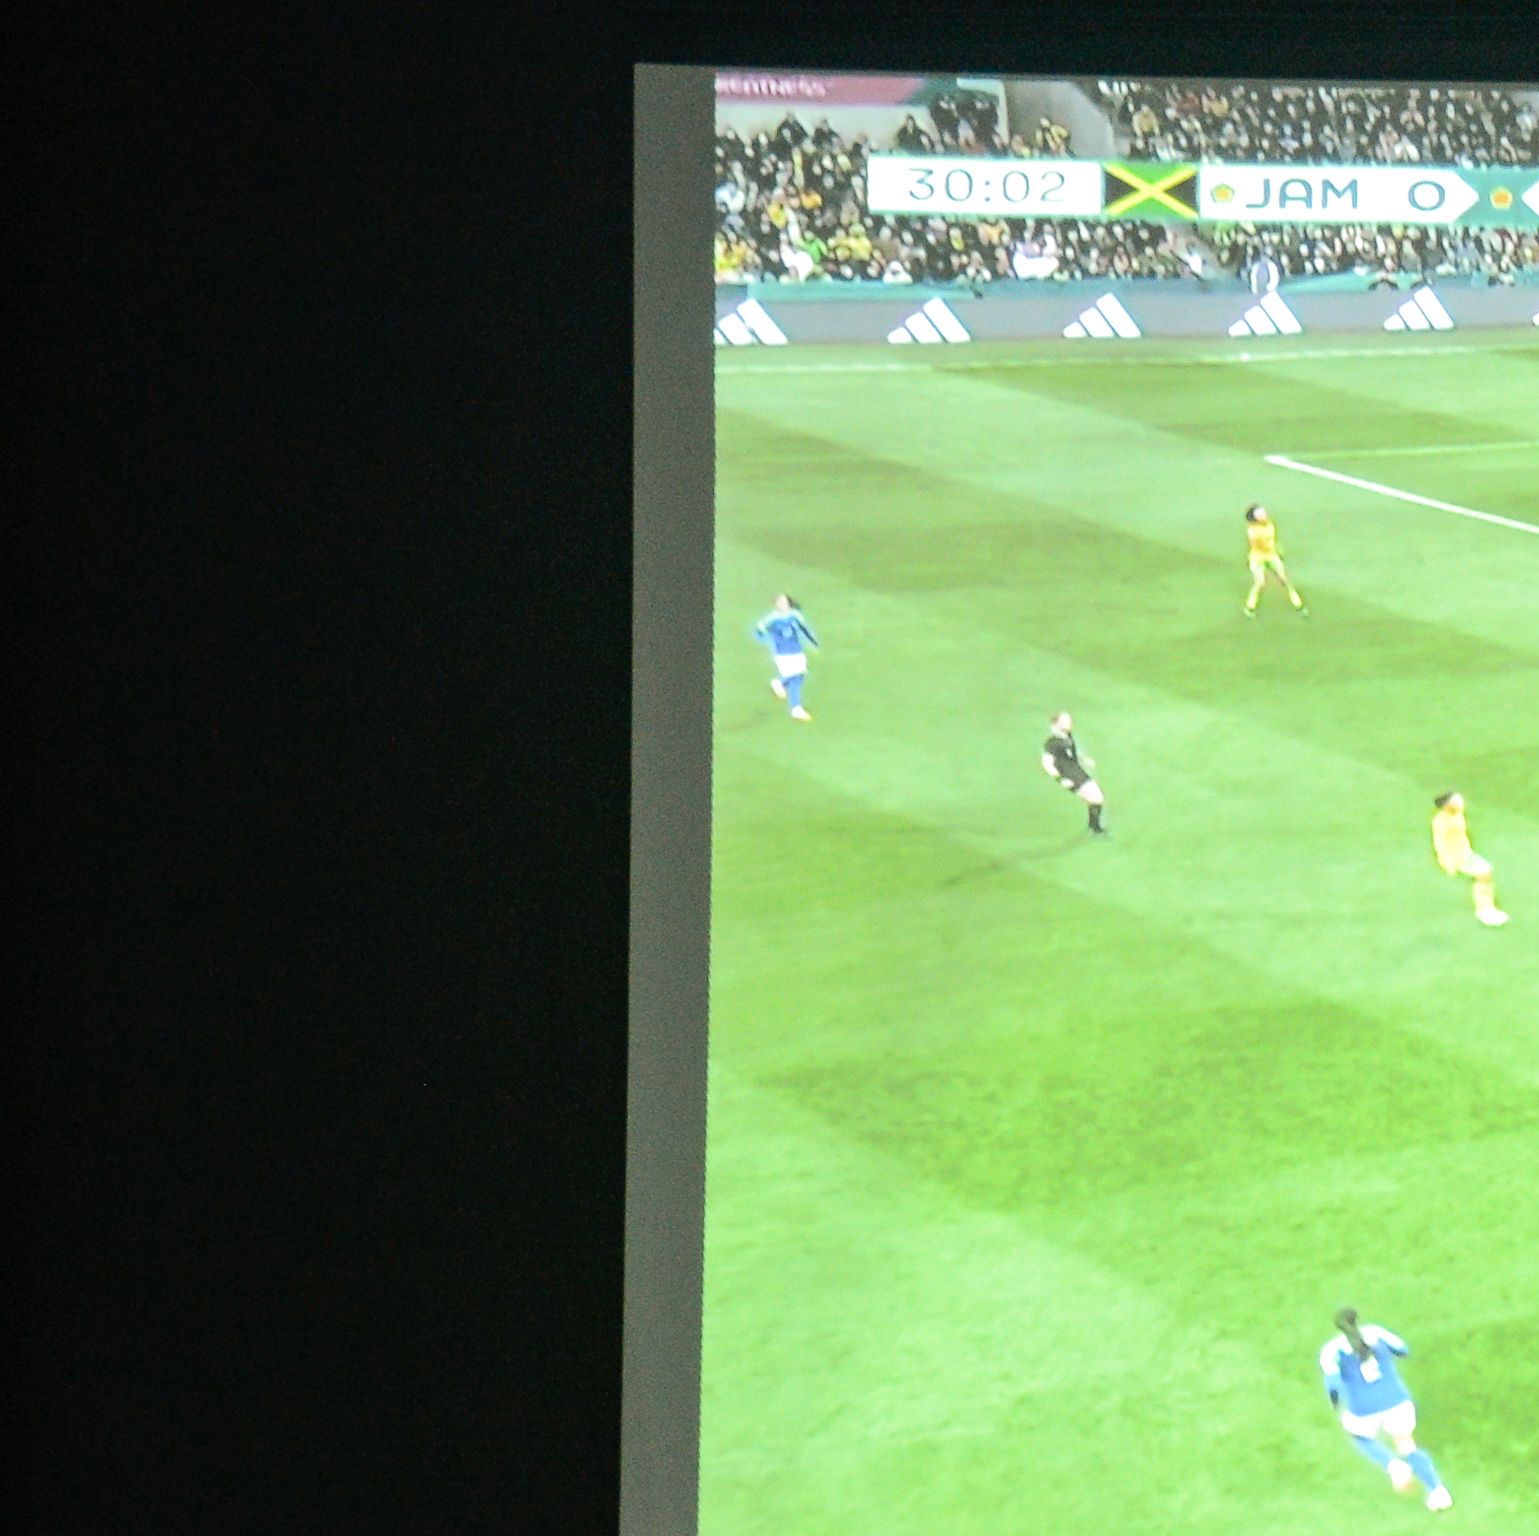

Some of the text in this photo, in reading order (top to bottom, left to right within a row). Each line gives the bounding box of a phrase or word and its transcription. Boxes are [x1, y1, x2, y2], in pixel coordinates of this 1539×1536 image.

[908, 166, 1068, 204] 30:02
[1246, 179, 1359, 210] JAM
[1407, 181, 1446, 212] 0
